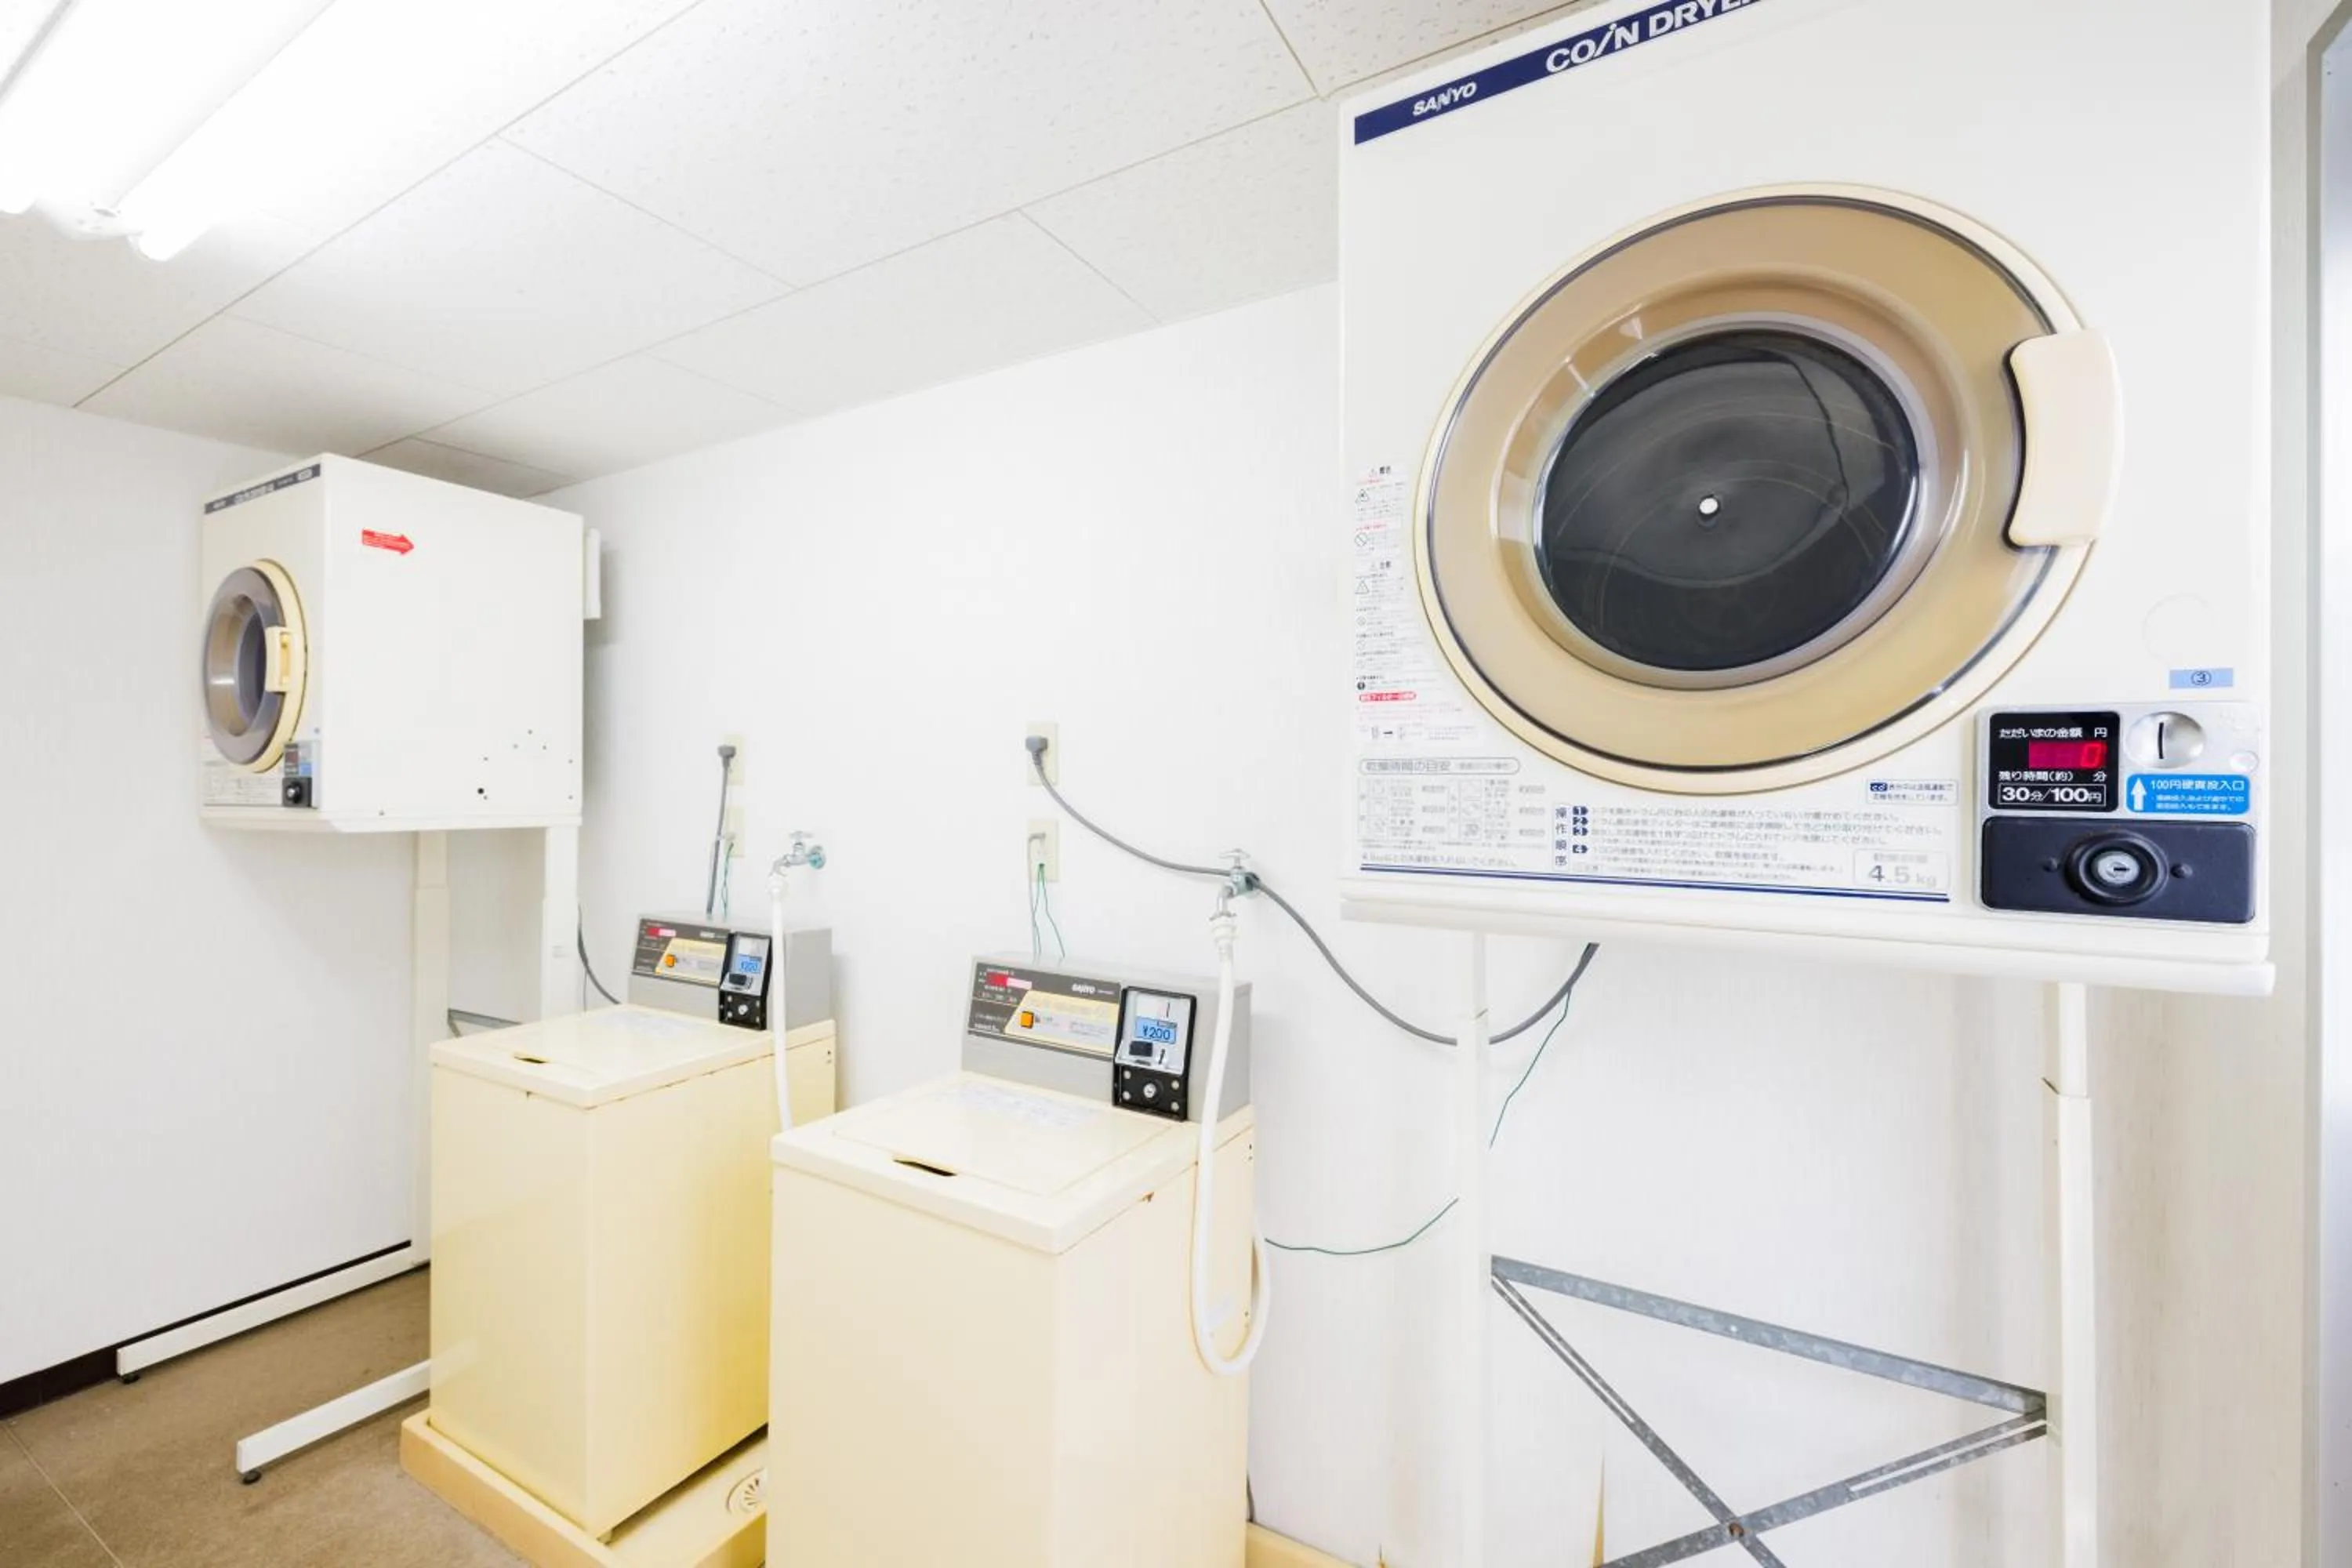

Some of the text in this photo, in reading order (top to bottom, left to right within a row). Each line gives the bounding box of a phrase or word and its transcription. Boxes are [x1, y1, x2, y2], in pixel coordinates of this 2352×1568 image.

[1413, 82, 1477, 116] SANYO
[1999, 727, 2108, 739] ただいまの金額 円
[2092, 771, 2107, 782] 分
[2151, 779, 2245, 791] 100円硬貨投入口
[1868, 865, 1911, 884] 4.5
[1142, 1025, 1171, 1040] ¥200
